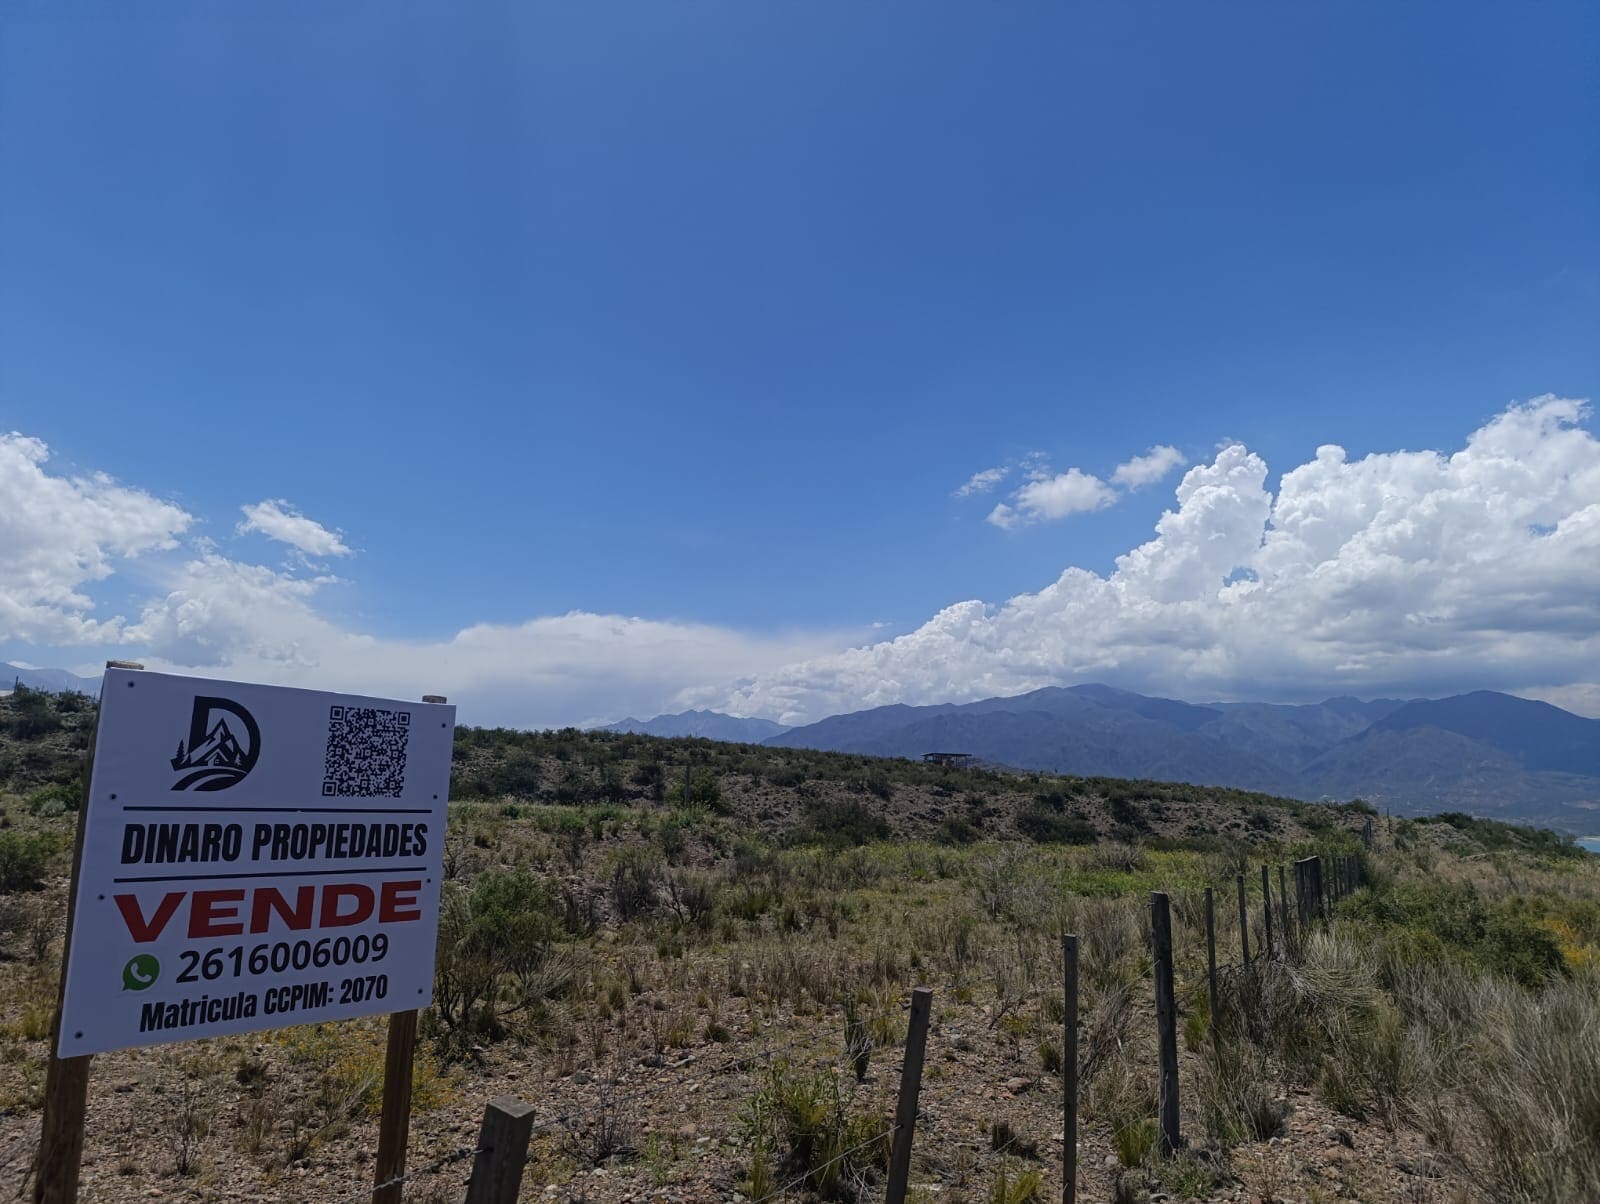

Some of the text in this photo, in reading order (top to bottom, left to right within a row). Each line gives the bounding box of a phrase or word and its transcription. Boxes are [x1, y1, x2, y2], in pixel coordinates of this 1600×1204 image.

[121, 823, 428, 864] DINARO PROPIEDADES
[113, 880, 422, 943] VENDE
[176, 933, 389, 983] 2616006009
[139, 974, 388, 1032] Matricula CCPIM: 2070
